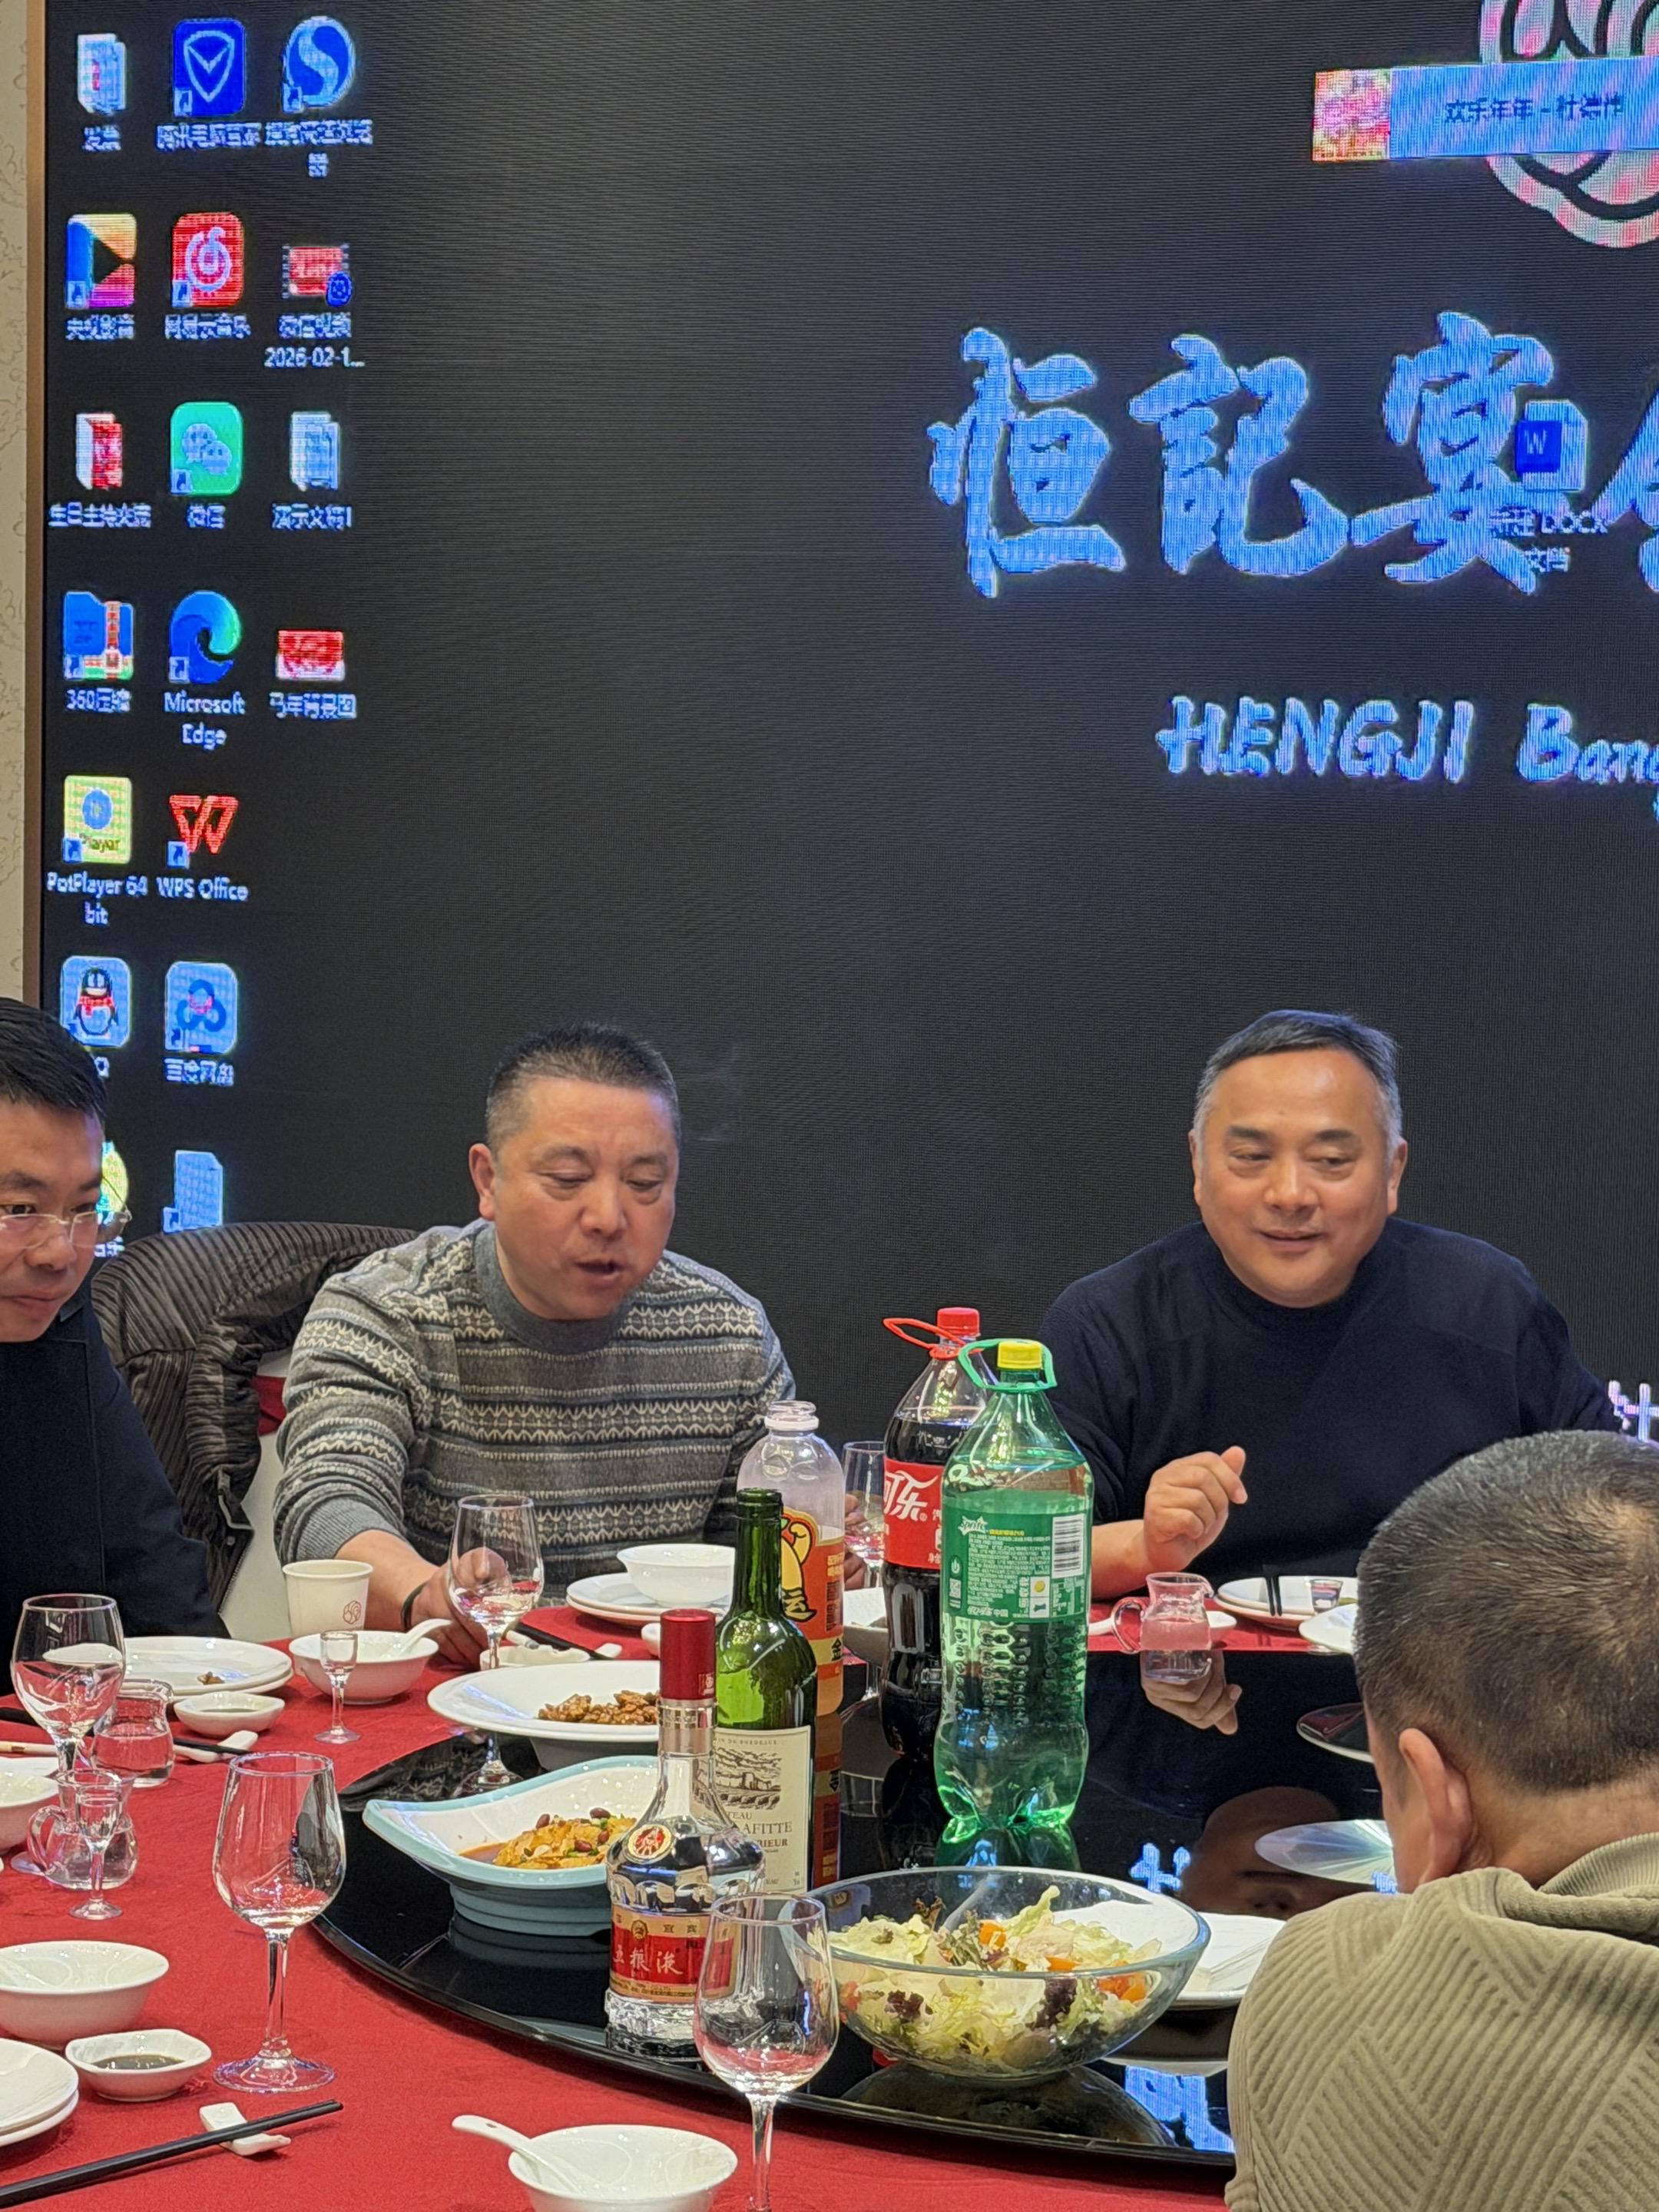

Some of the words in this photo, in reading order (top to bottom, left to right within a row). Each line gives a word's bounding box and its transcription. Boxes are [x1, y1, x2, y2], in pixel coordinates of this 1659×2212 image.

[164, 690, 246, 714] Microsoft
[182, 722, 227, 751] Edge
[1156, 697, 1474, 781] HENGJI
[1517, 704, 1659, 823] Ban
[47, 872, 123, 899] PotPlayer
[126, 876, 148, 897] 64
[157, 877, 194, 899] WPS
[197, 876, 250, 900] Office
[84, 902, 109, 925] bit
[728, 1811, 753, 1820] TEAU
[743, 1821, 793, 1834] AFITTE
[757, 1838, 788, 1847] RIEUR
